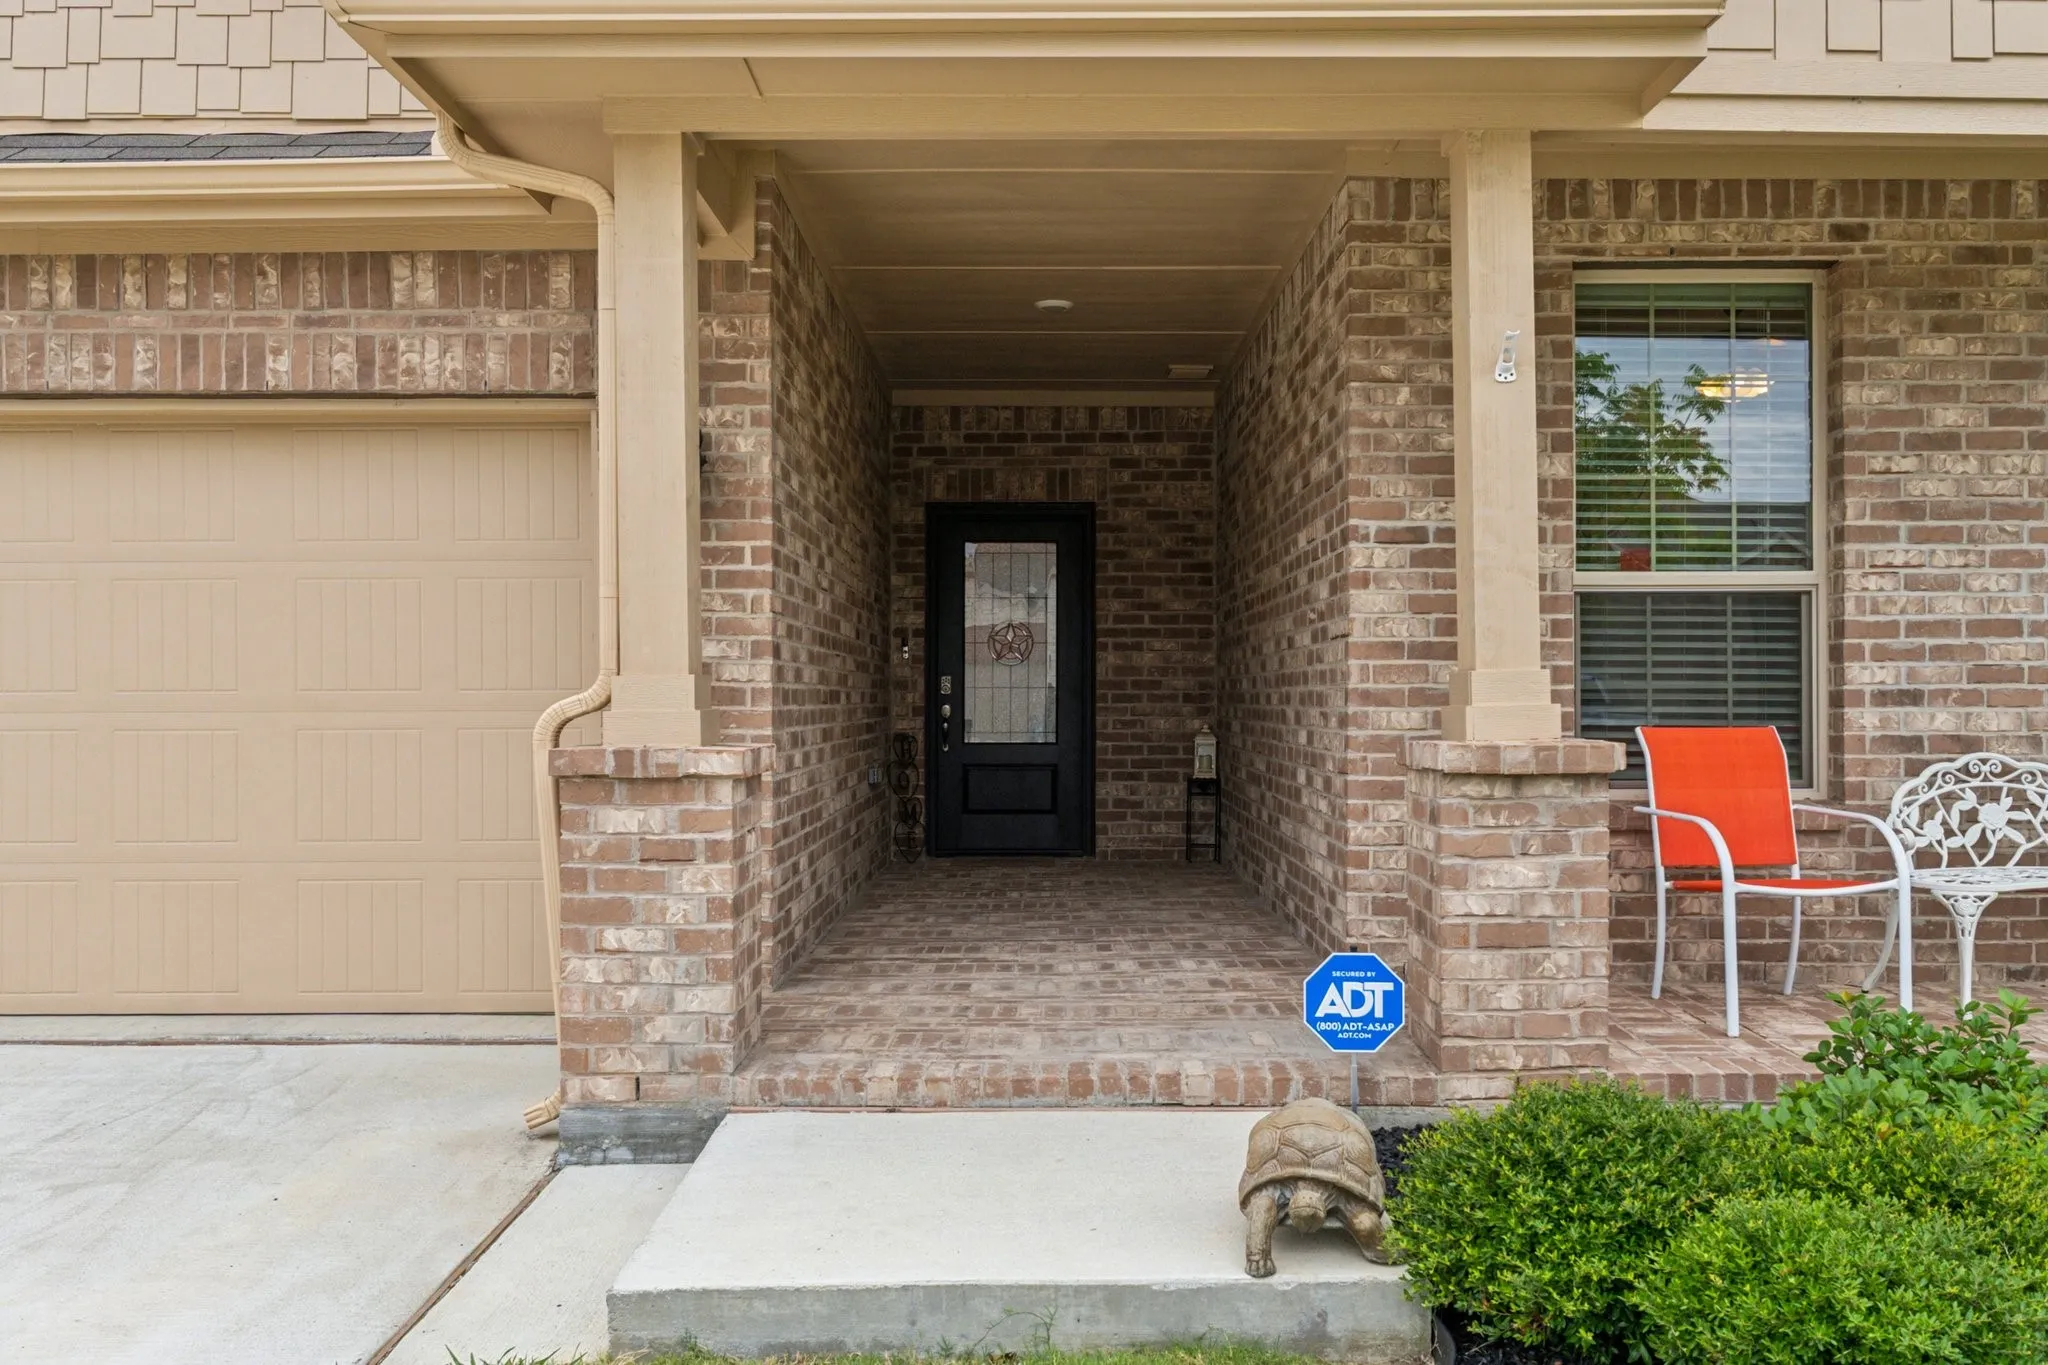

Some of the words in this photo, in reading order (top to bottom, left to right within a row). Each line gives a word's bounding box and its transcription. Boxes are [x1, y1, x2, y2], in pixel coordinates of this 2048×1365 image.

[1314, 981, 1394, 1018] ADT
[1316, 1021, 1341, 1032] (800)
[1342, 1022, 1395, 1031] ADT-ASAP
